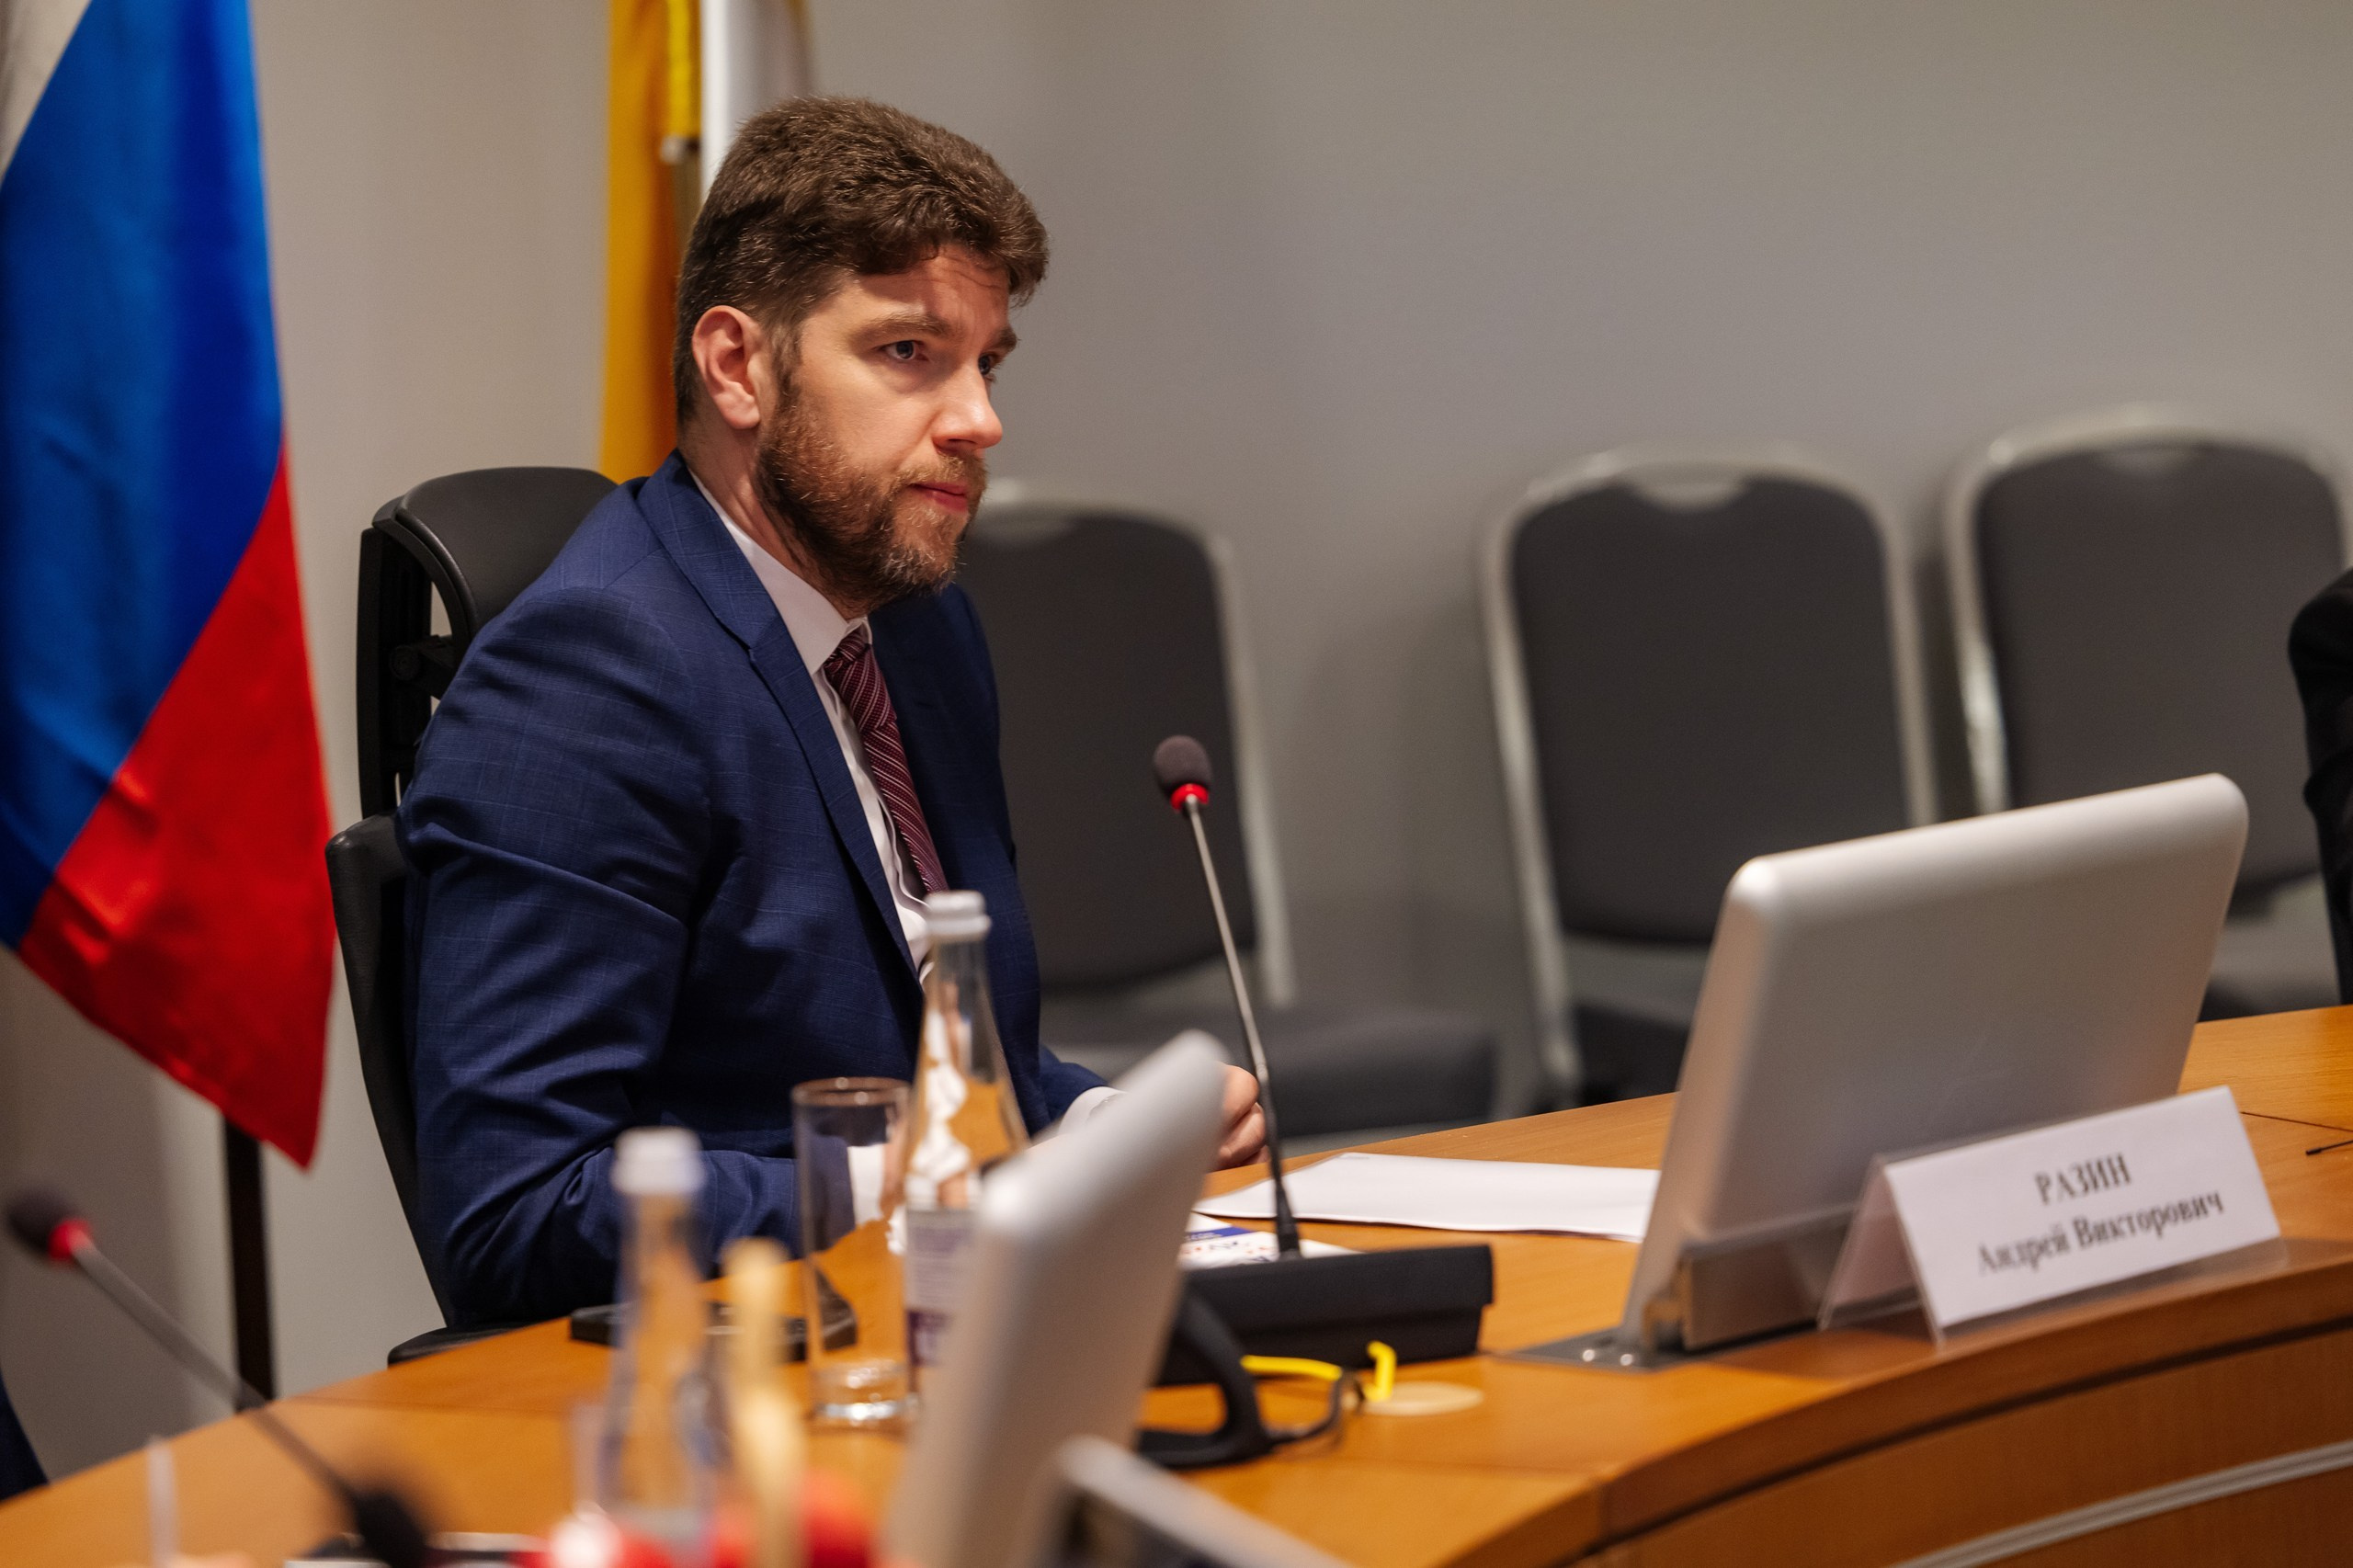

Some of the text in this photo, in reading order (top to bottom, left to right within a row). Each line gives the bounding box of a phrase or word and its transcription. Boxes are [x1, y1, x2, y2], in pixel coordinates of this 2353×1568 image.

[2034, 1153, 2131, 1206] РАЗИН
[1978, 1190, 2224, 1274] Андрей Викторович
